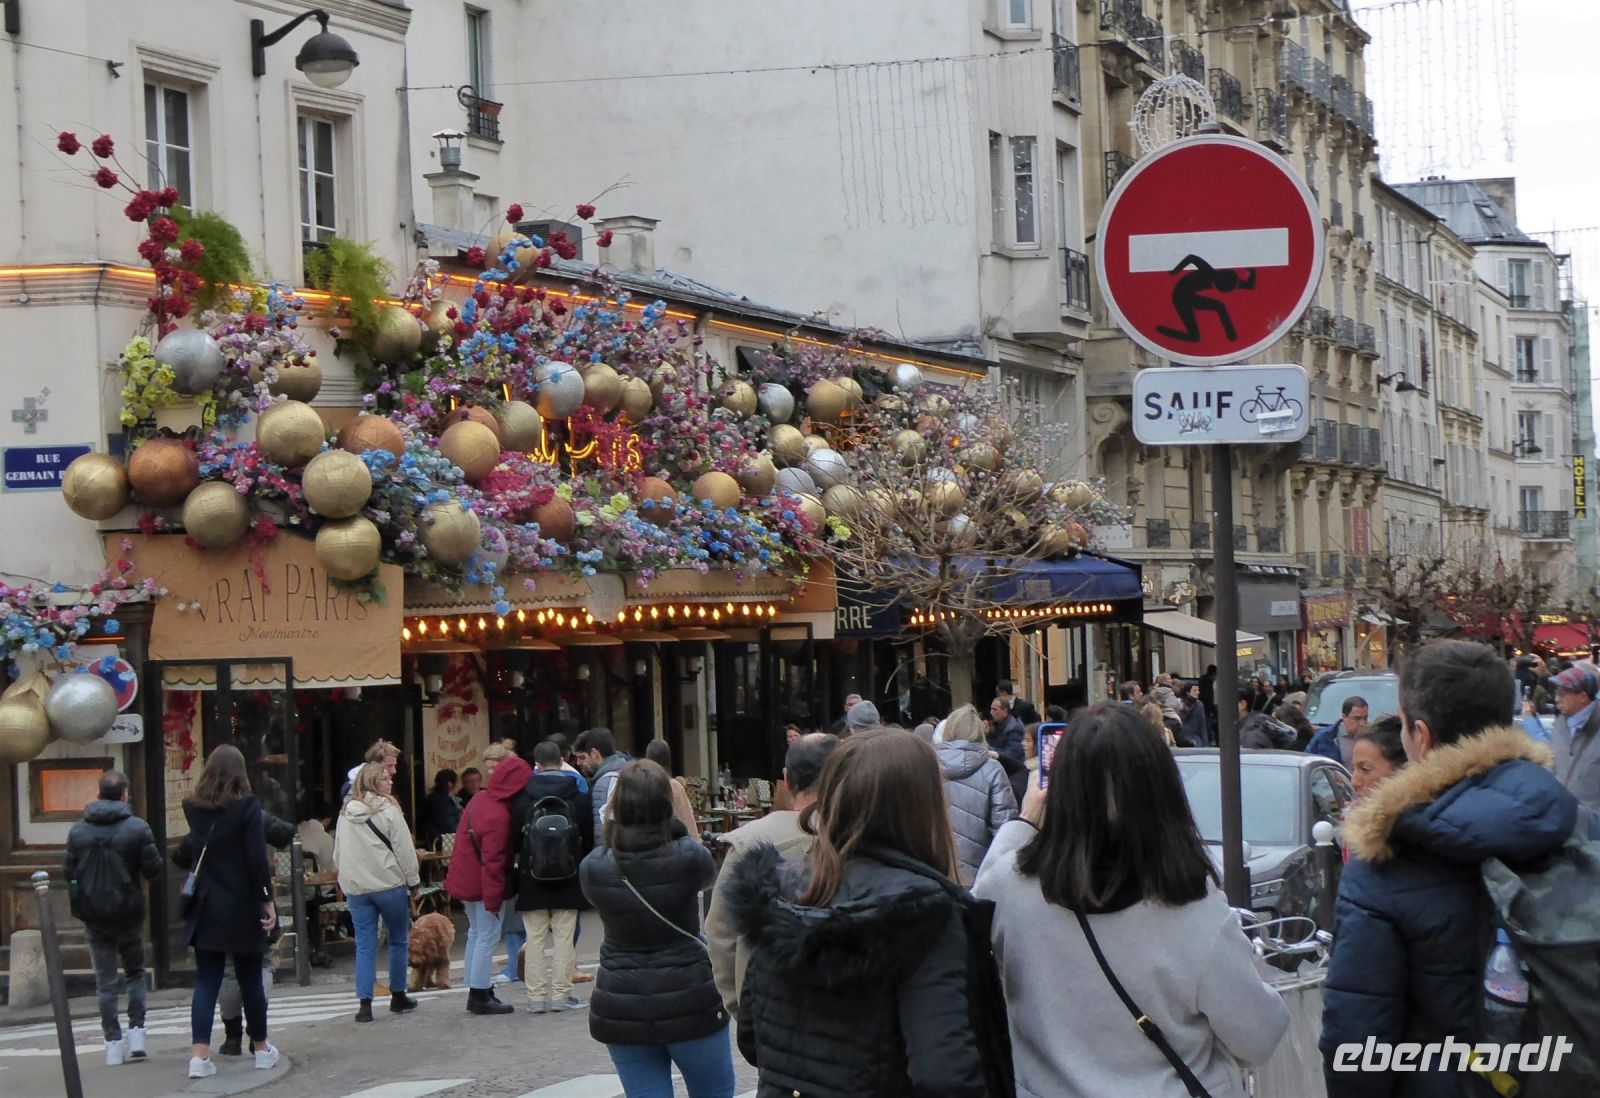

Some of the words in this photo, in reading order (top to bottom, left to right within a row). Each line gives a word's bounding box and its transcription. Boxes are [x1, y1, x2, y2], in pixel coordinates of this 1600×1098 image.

[36, 453, 60, 463] RUE
[5, 470, 55, 481] GERMAIN
[1574, 456, 1585, 506] HOTEL
[284, 563, 369, 622] PARIS
[239, 625, 320, 642] Montmartre
